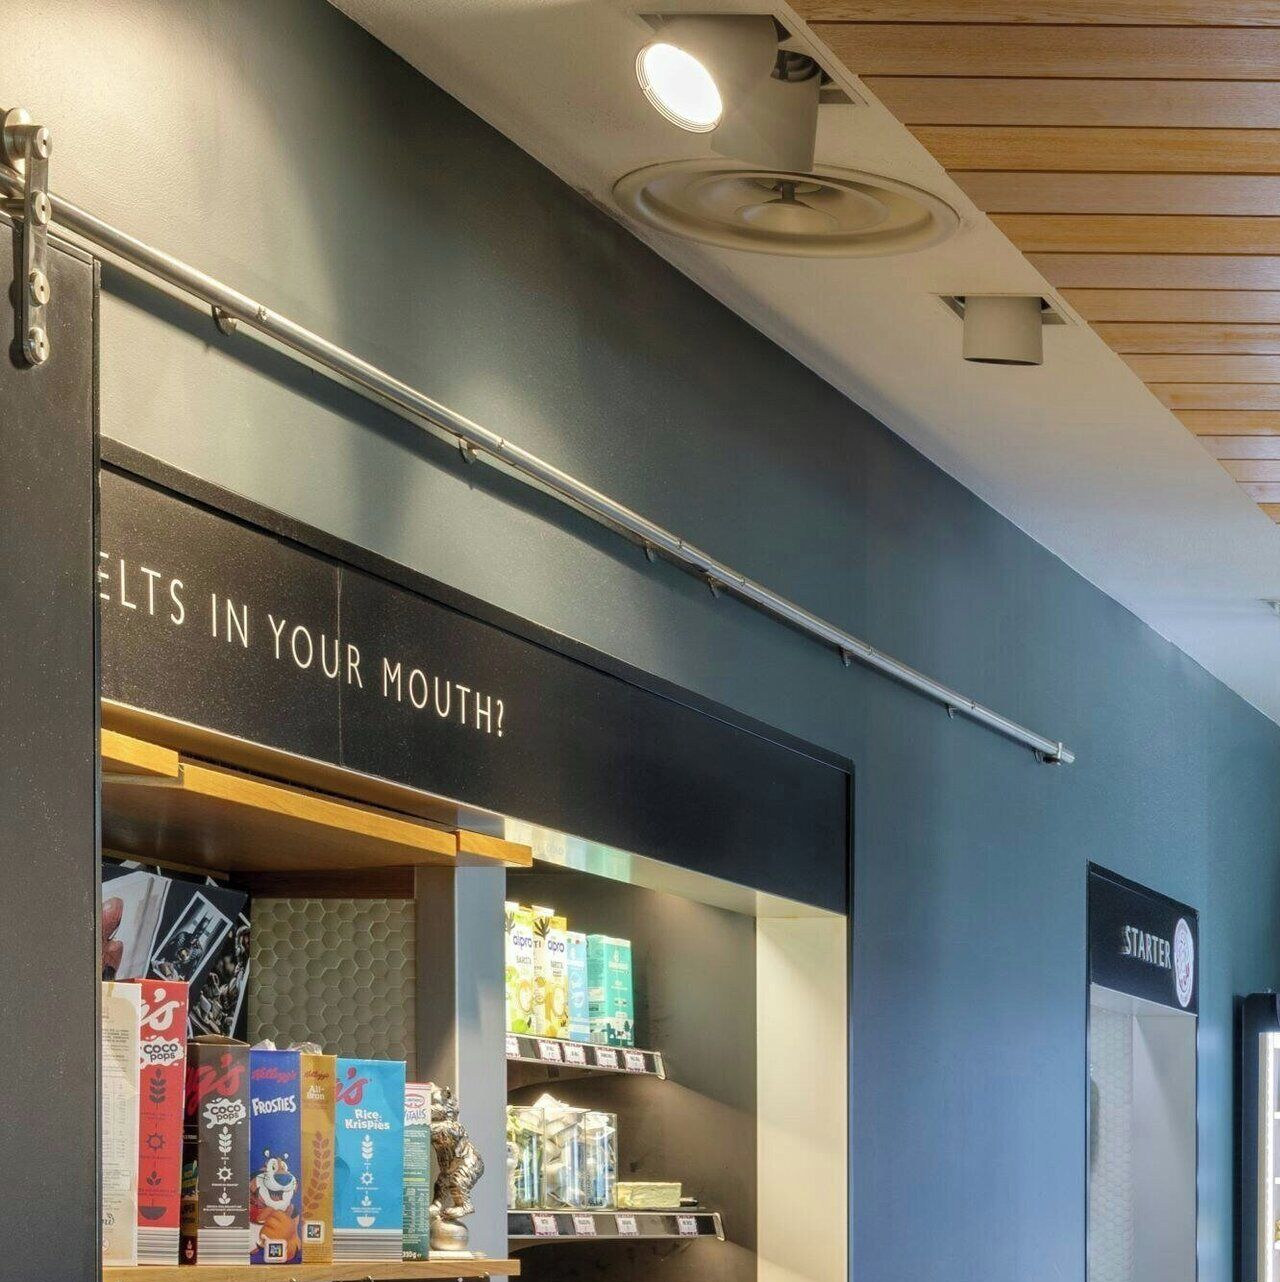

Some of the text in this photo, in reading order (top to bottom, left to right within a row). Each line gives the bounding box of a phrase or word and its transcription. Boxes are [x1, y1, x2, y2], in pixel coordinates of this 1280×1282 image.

[211, 593, 248, 648] IN
[267, 614, 363, 688] YOUR
[383, 657, 504, 738] MOUTH?
[1120, 925, 1172, 969] STARTER
[345, 1119, 390, 1131] Krispies
[354, 1109, 380, 1120] Rice
